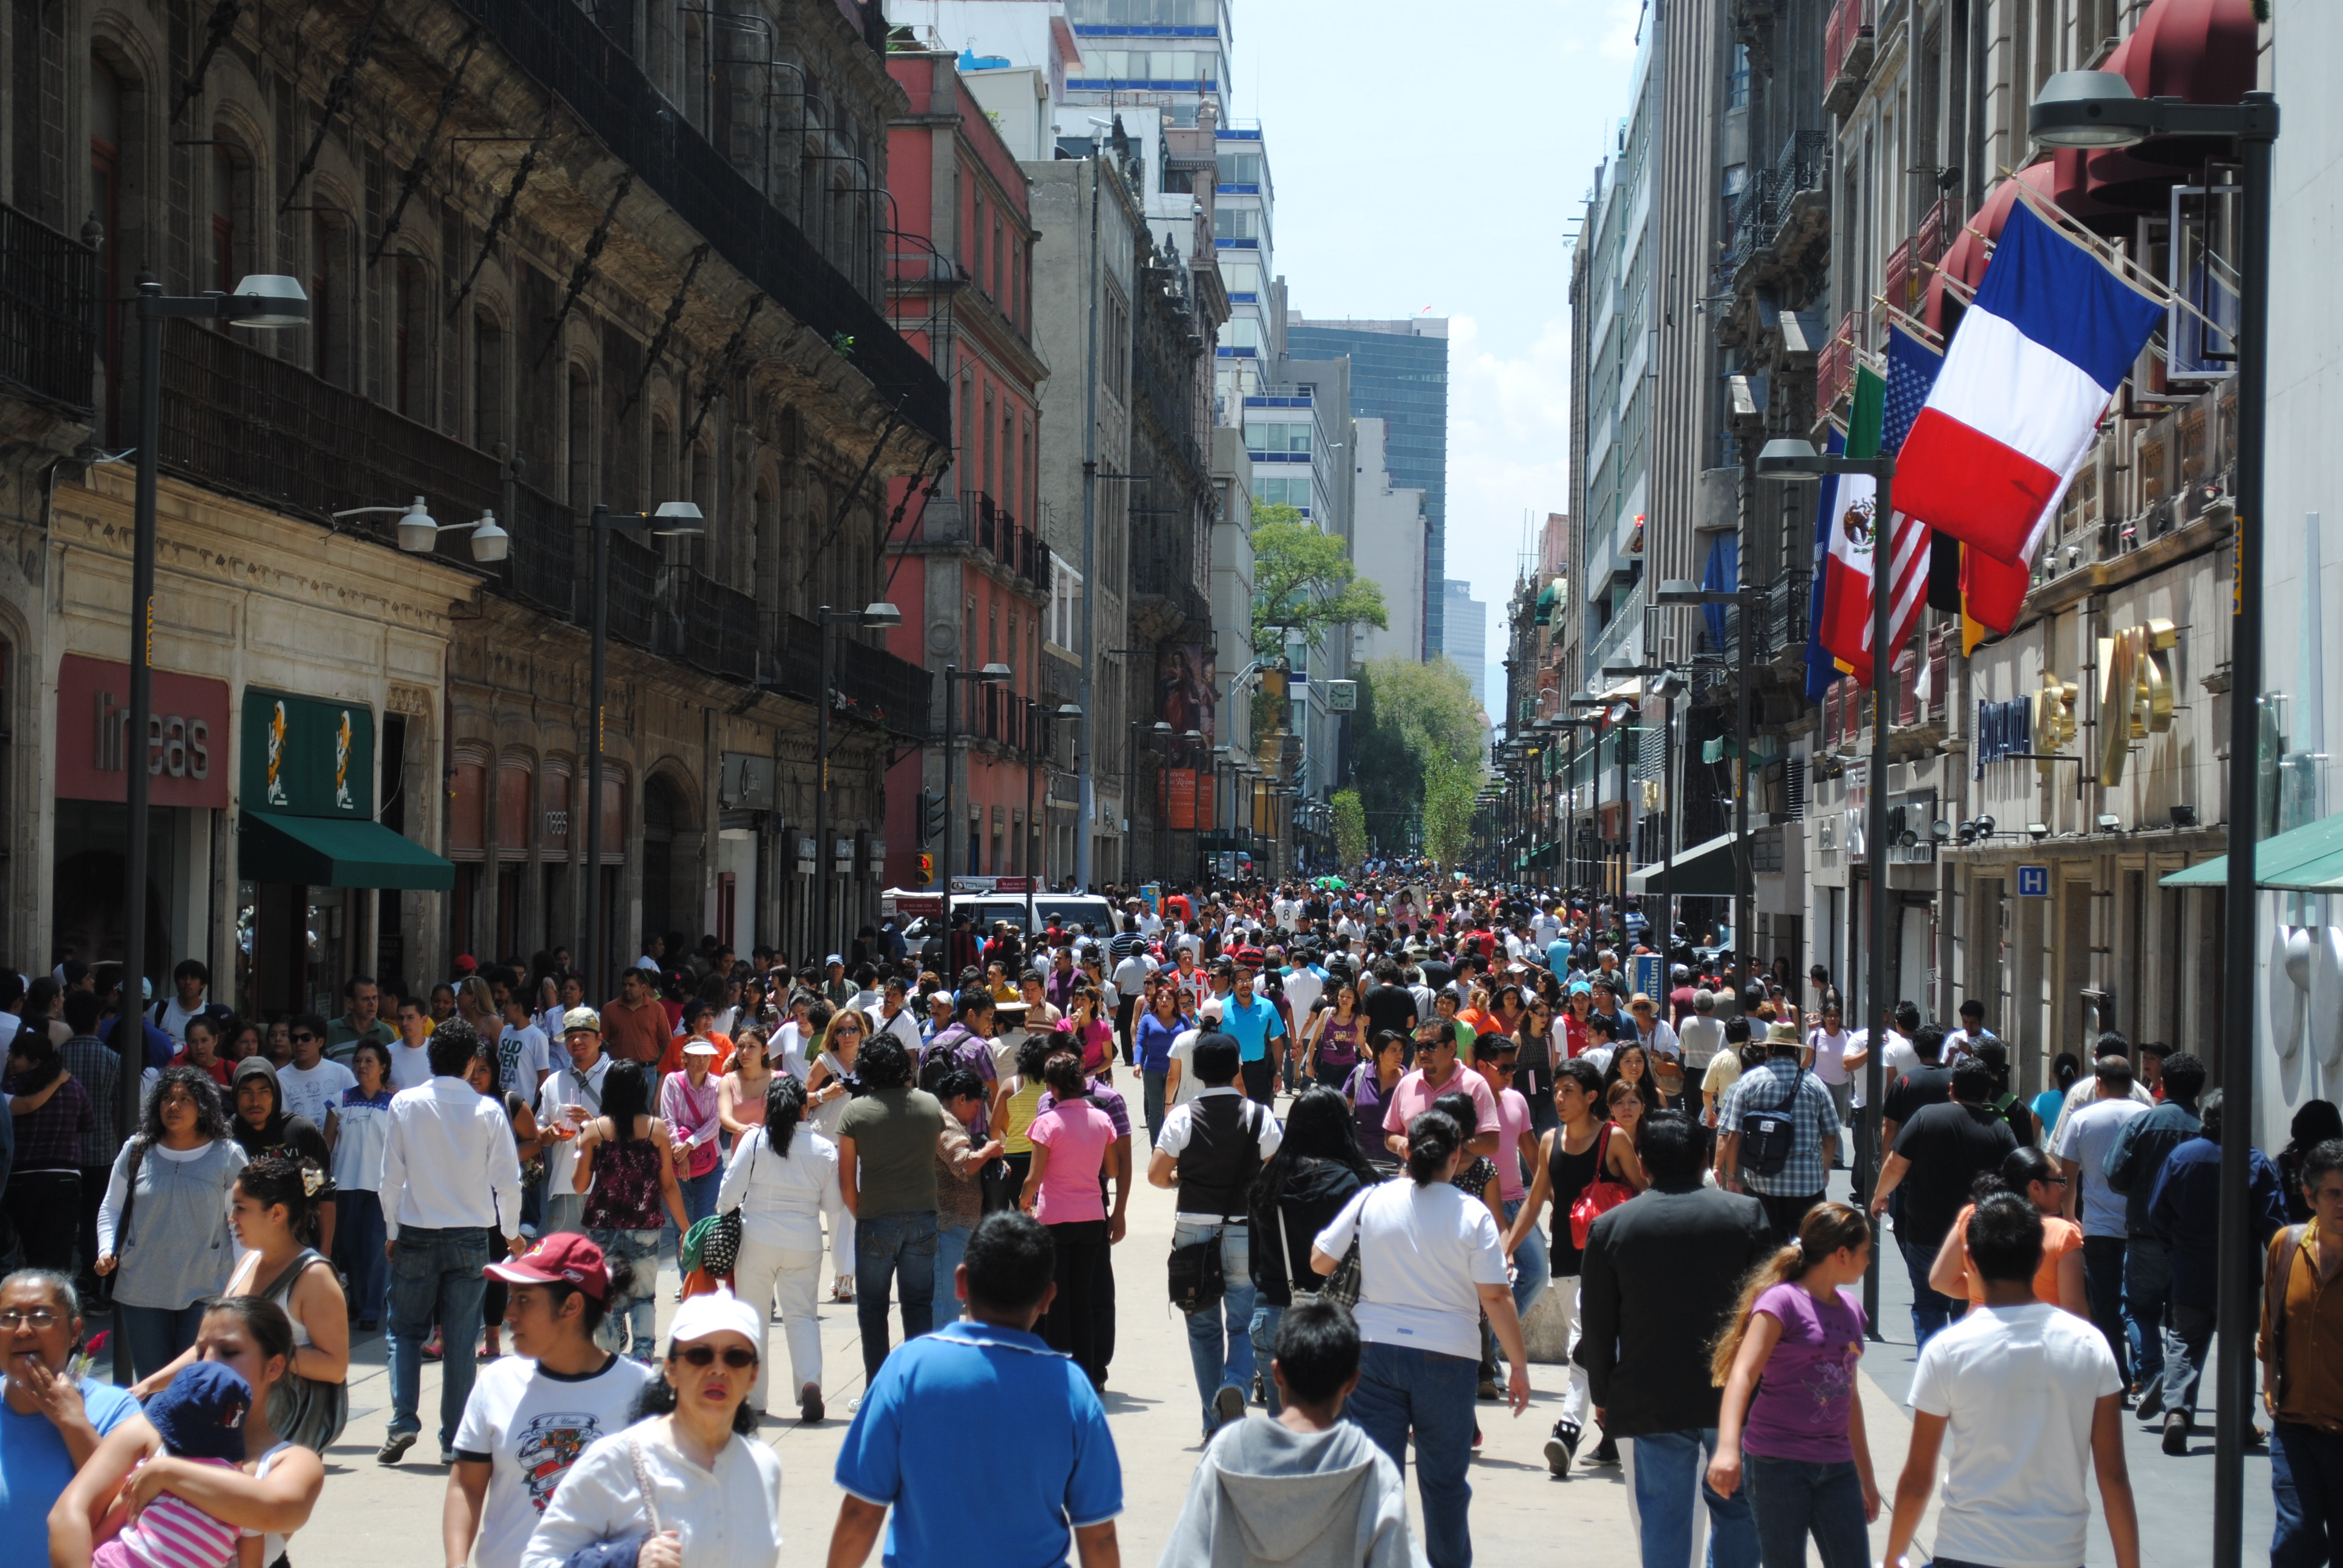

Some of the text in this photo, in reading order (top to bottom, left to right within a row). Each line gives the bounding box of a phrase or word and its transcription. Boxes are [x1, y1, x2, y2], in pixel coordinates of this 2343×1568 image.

[2025, 871, 2042, 892] H
[1283, 909, 1289, 921] 8
[499, 1038, 522, 1054] SUD
